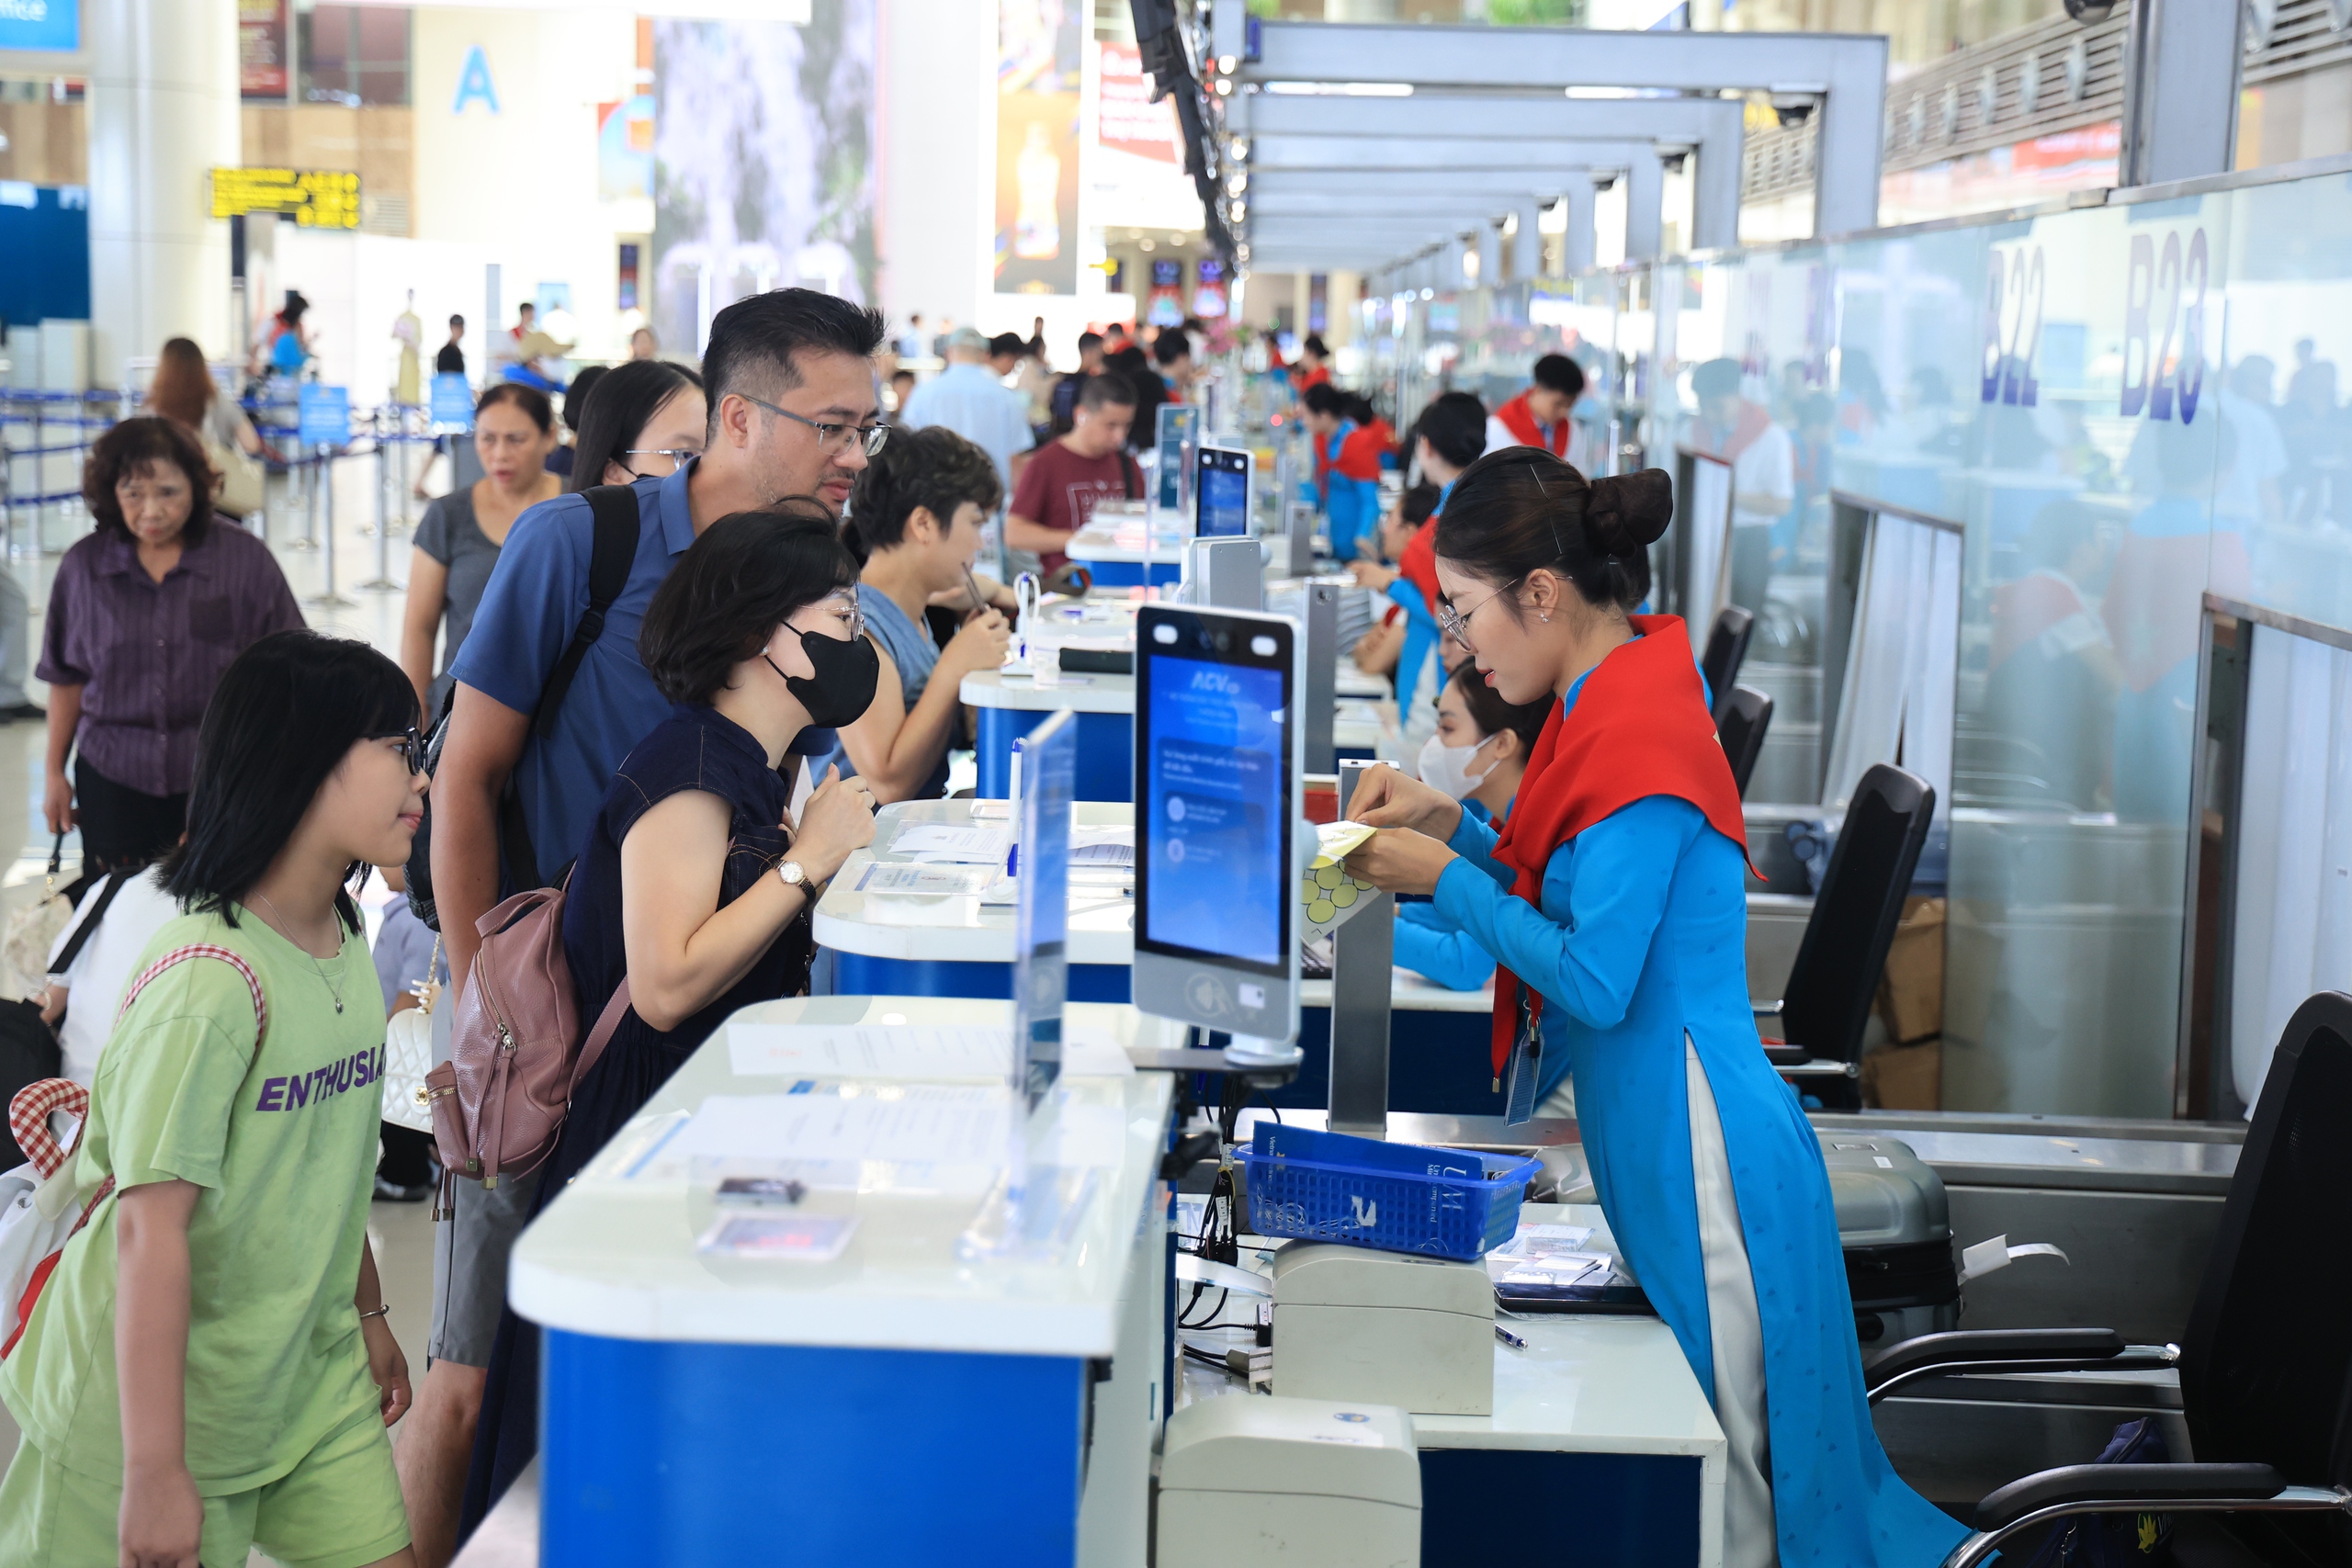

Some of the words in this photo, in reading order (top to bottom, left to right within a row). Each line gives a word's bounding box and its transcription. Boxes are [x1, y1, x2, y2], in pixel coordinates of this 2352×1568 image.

[451, 44, 502, 115] A
[1982, 244, 2043, 407] B22
[2120, 227, 2209, 425] B23
